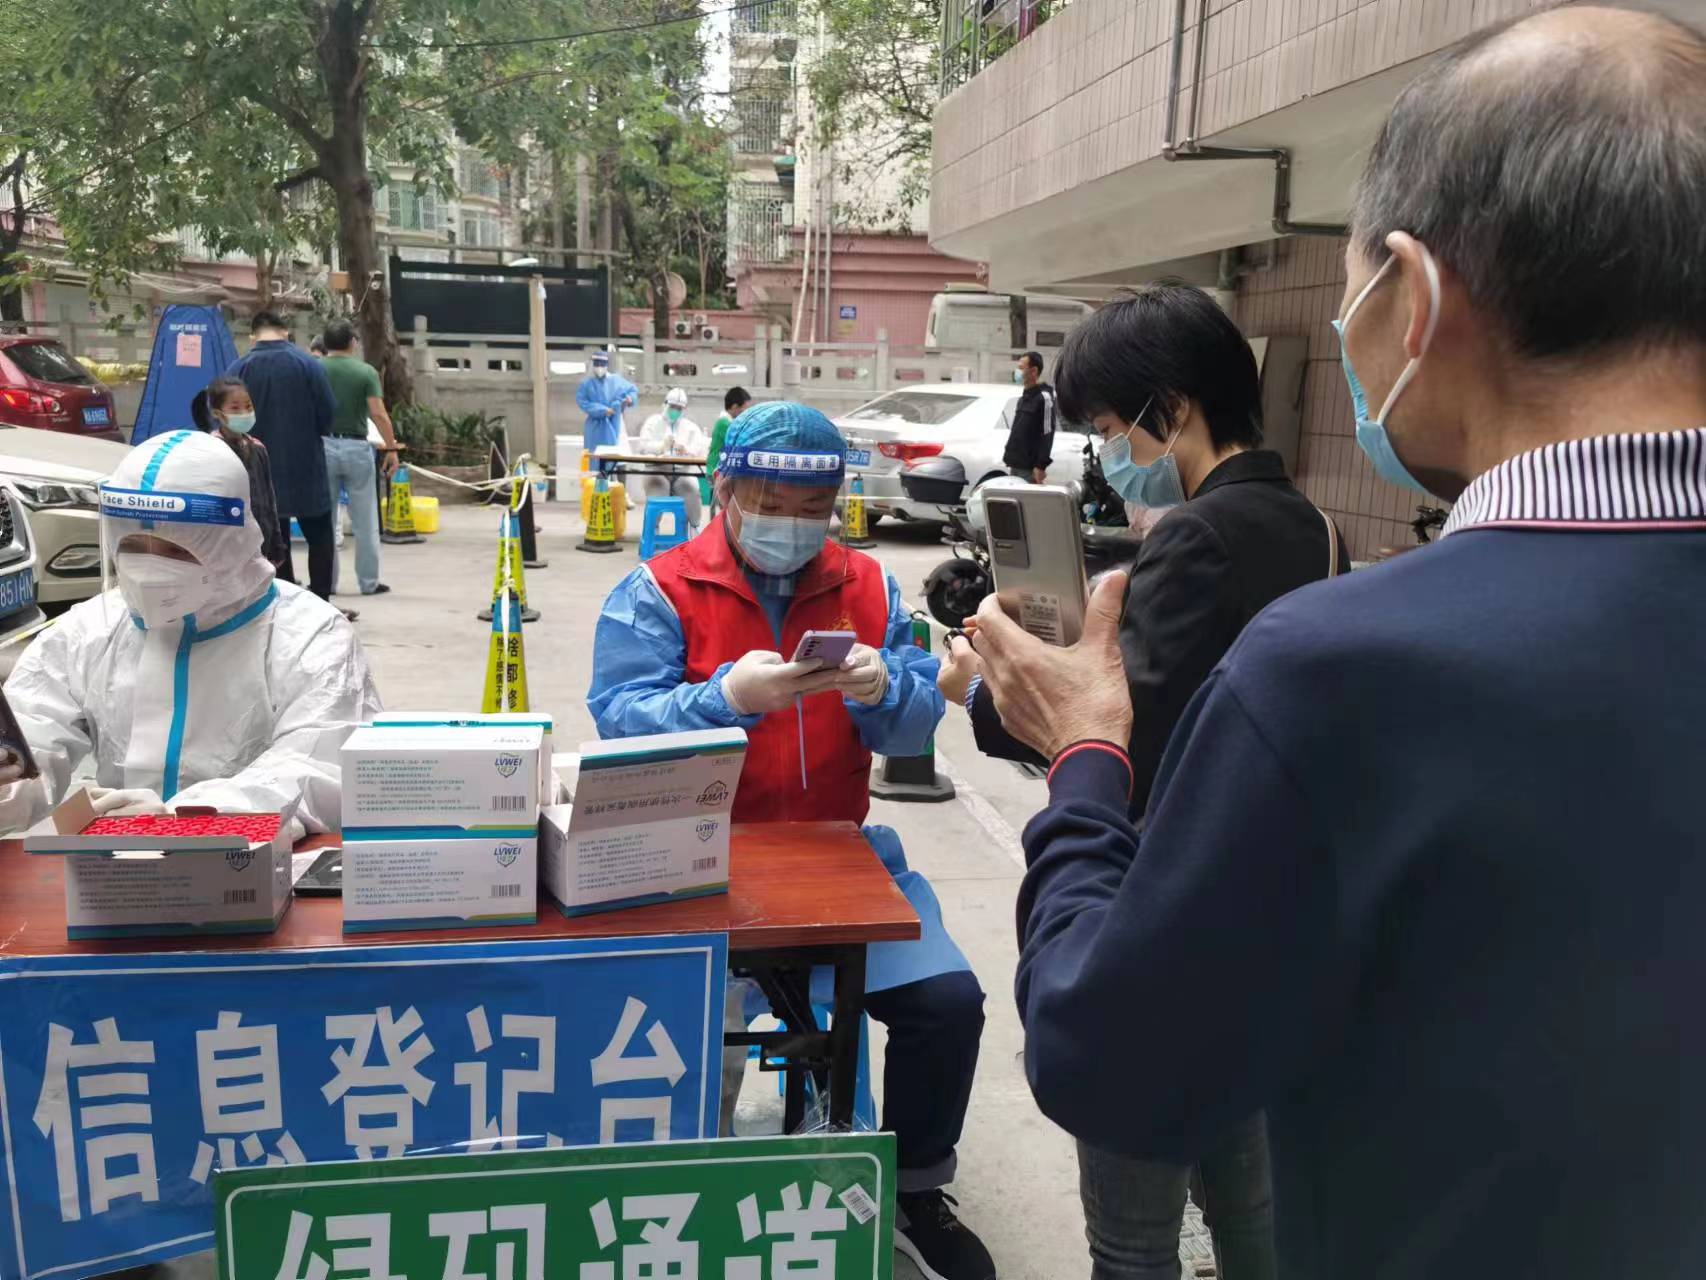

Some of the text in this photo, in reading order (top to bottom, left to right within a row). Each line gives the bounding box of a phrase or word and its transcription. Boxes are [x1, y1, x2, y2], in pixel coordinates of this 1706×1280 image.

[128, 495, 175, 509] Shield
[494, 757, 522, 767] LVWEI
[494, 846, 521, 857] LVWEI
[33, 996, 688, 1222] 信息登记台
